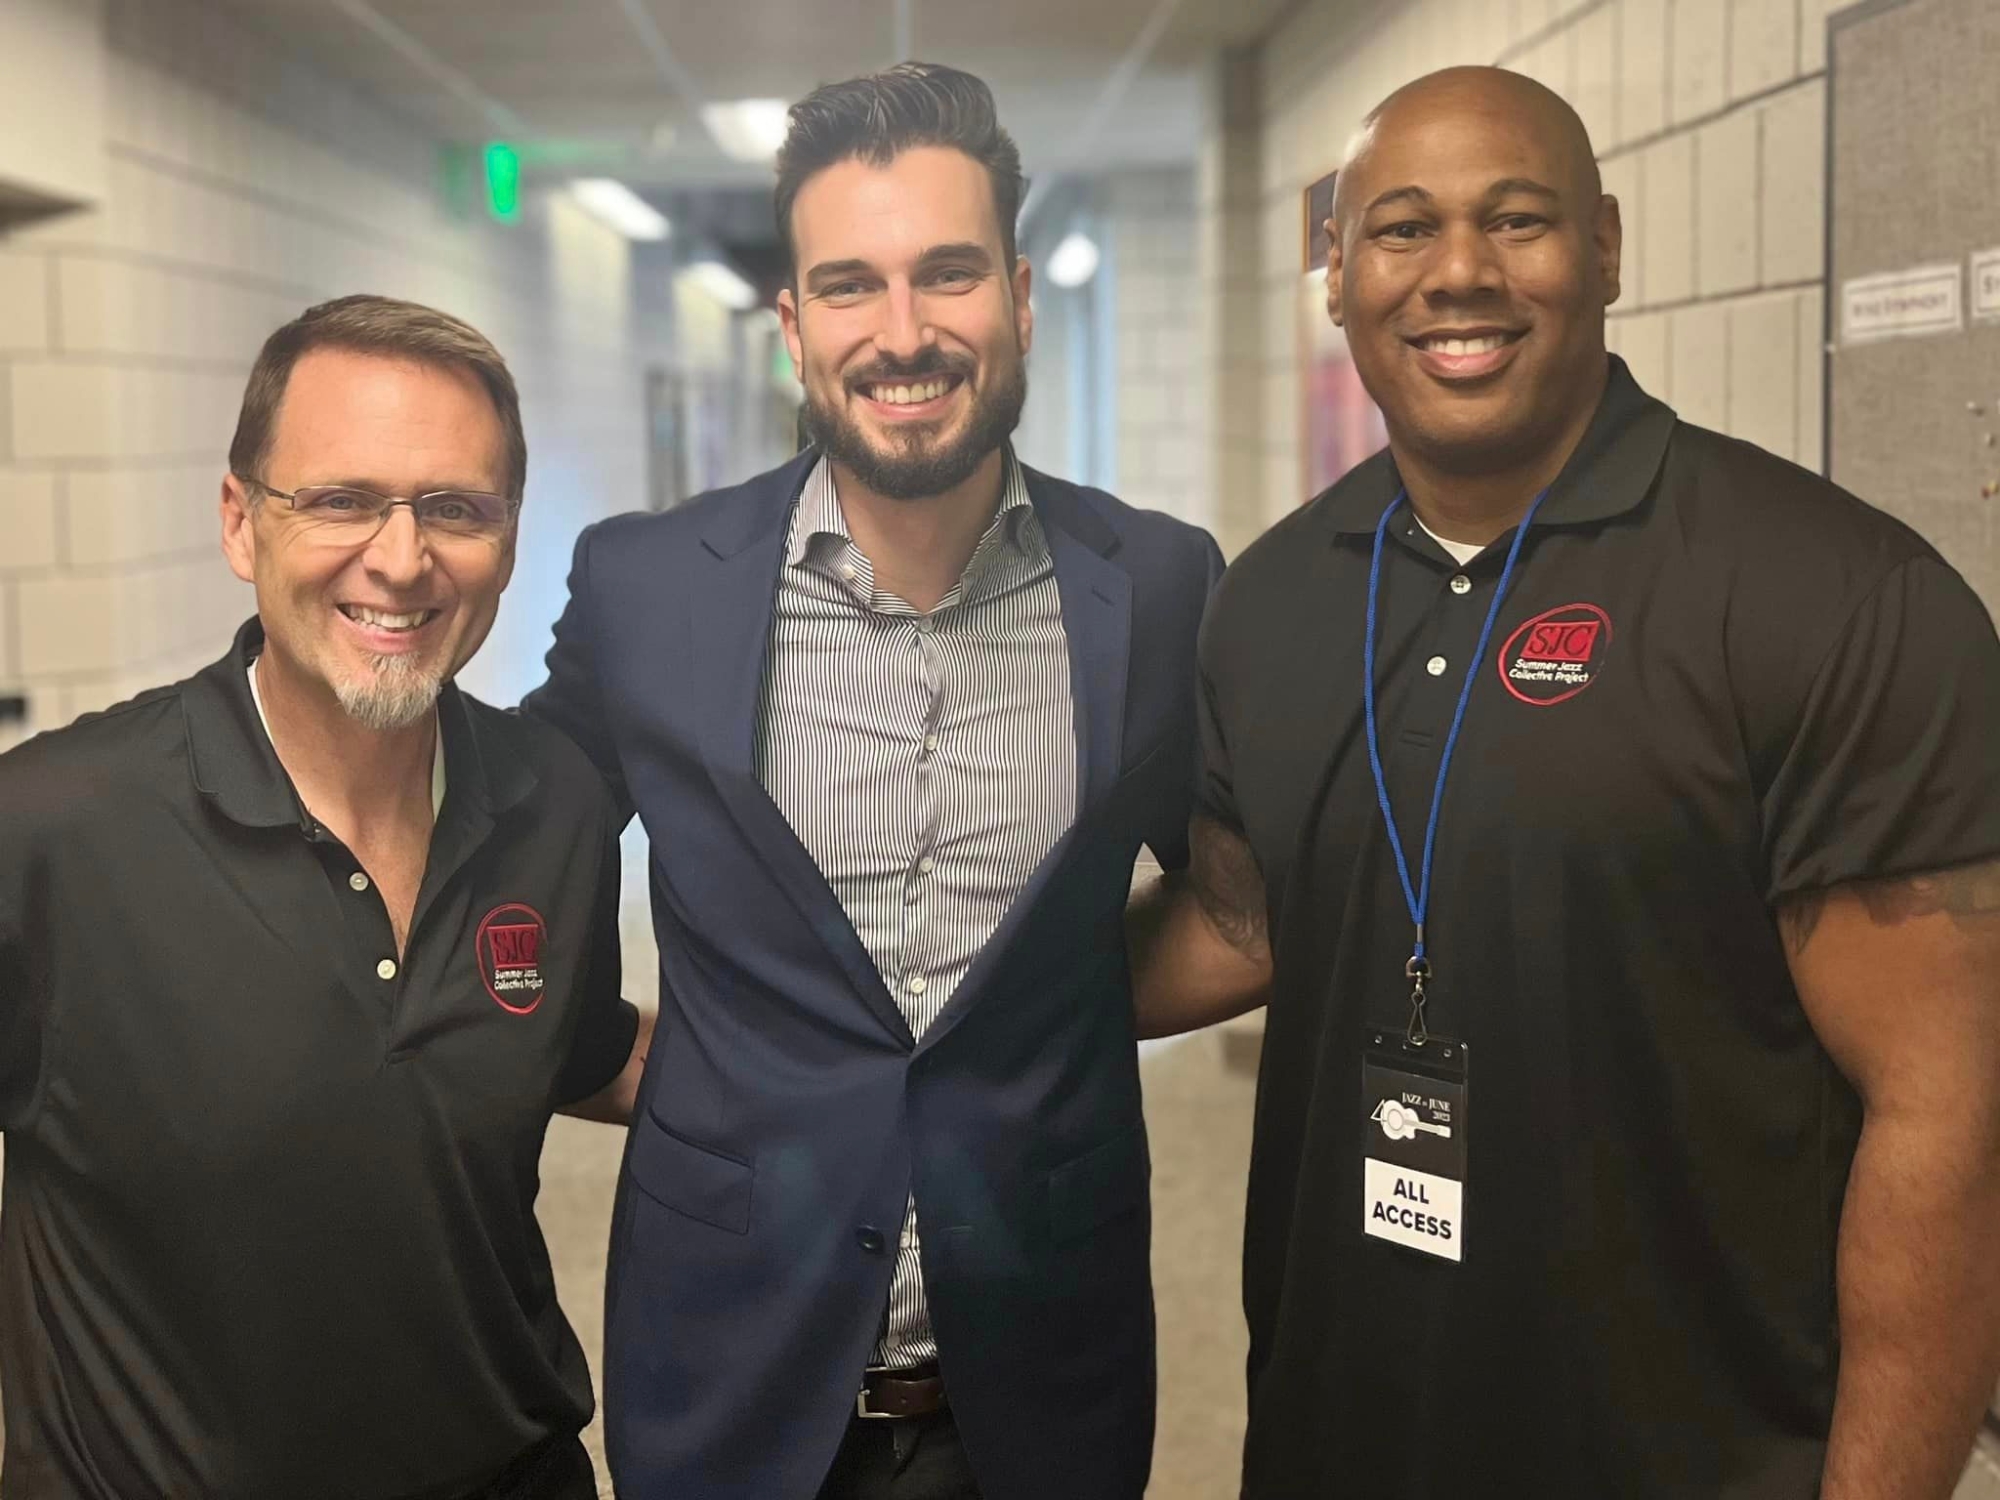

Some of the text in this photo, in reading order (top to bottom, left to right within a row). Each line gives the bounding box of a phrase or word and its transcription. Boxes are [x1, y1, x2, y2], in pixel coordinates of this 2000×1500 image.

[1528, 625, 1592, 656] SJC
[1508, 668, 1589, 684] Collective Project
[1515, 659, 1582, 671] Summer Jazz
[1402, 1092, 1421, 1105] JAZZ
[1428, 1098, 1451, 1112] JUNE
[1393, 1178, 1429, 1204] ALL
[1372, 1200, 1452, 1240] ACCESS
